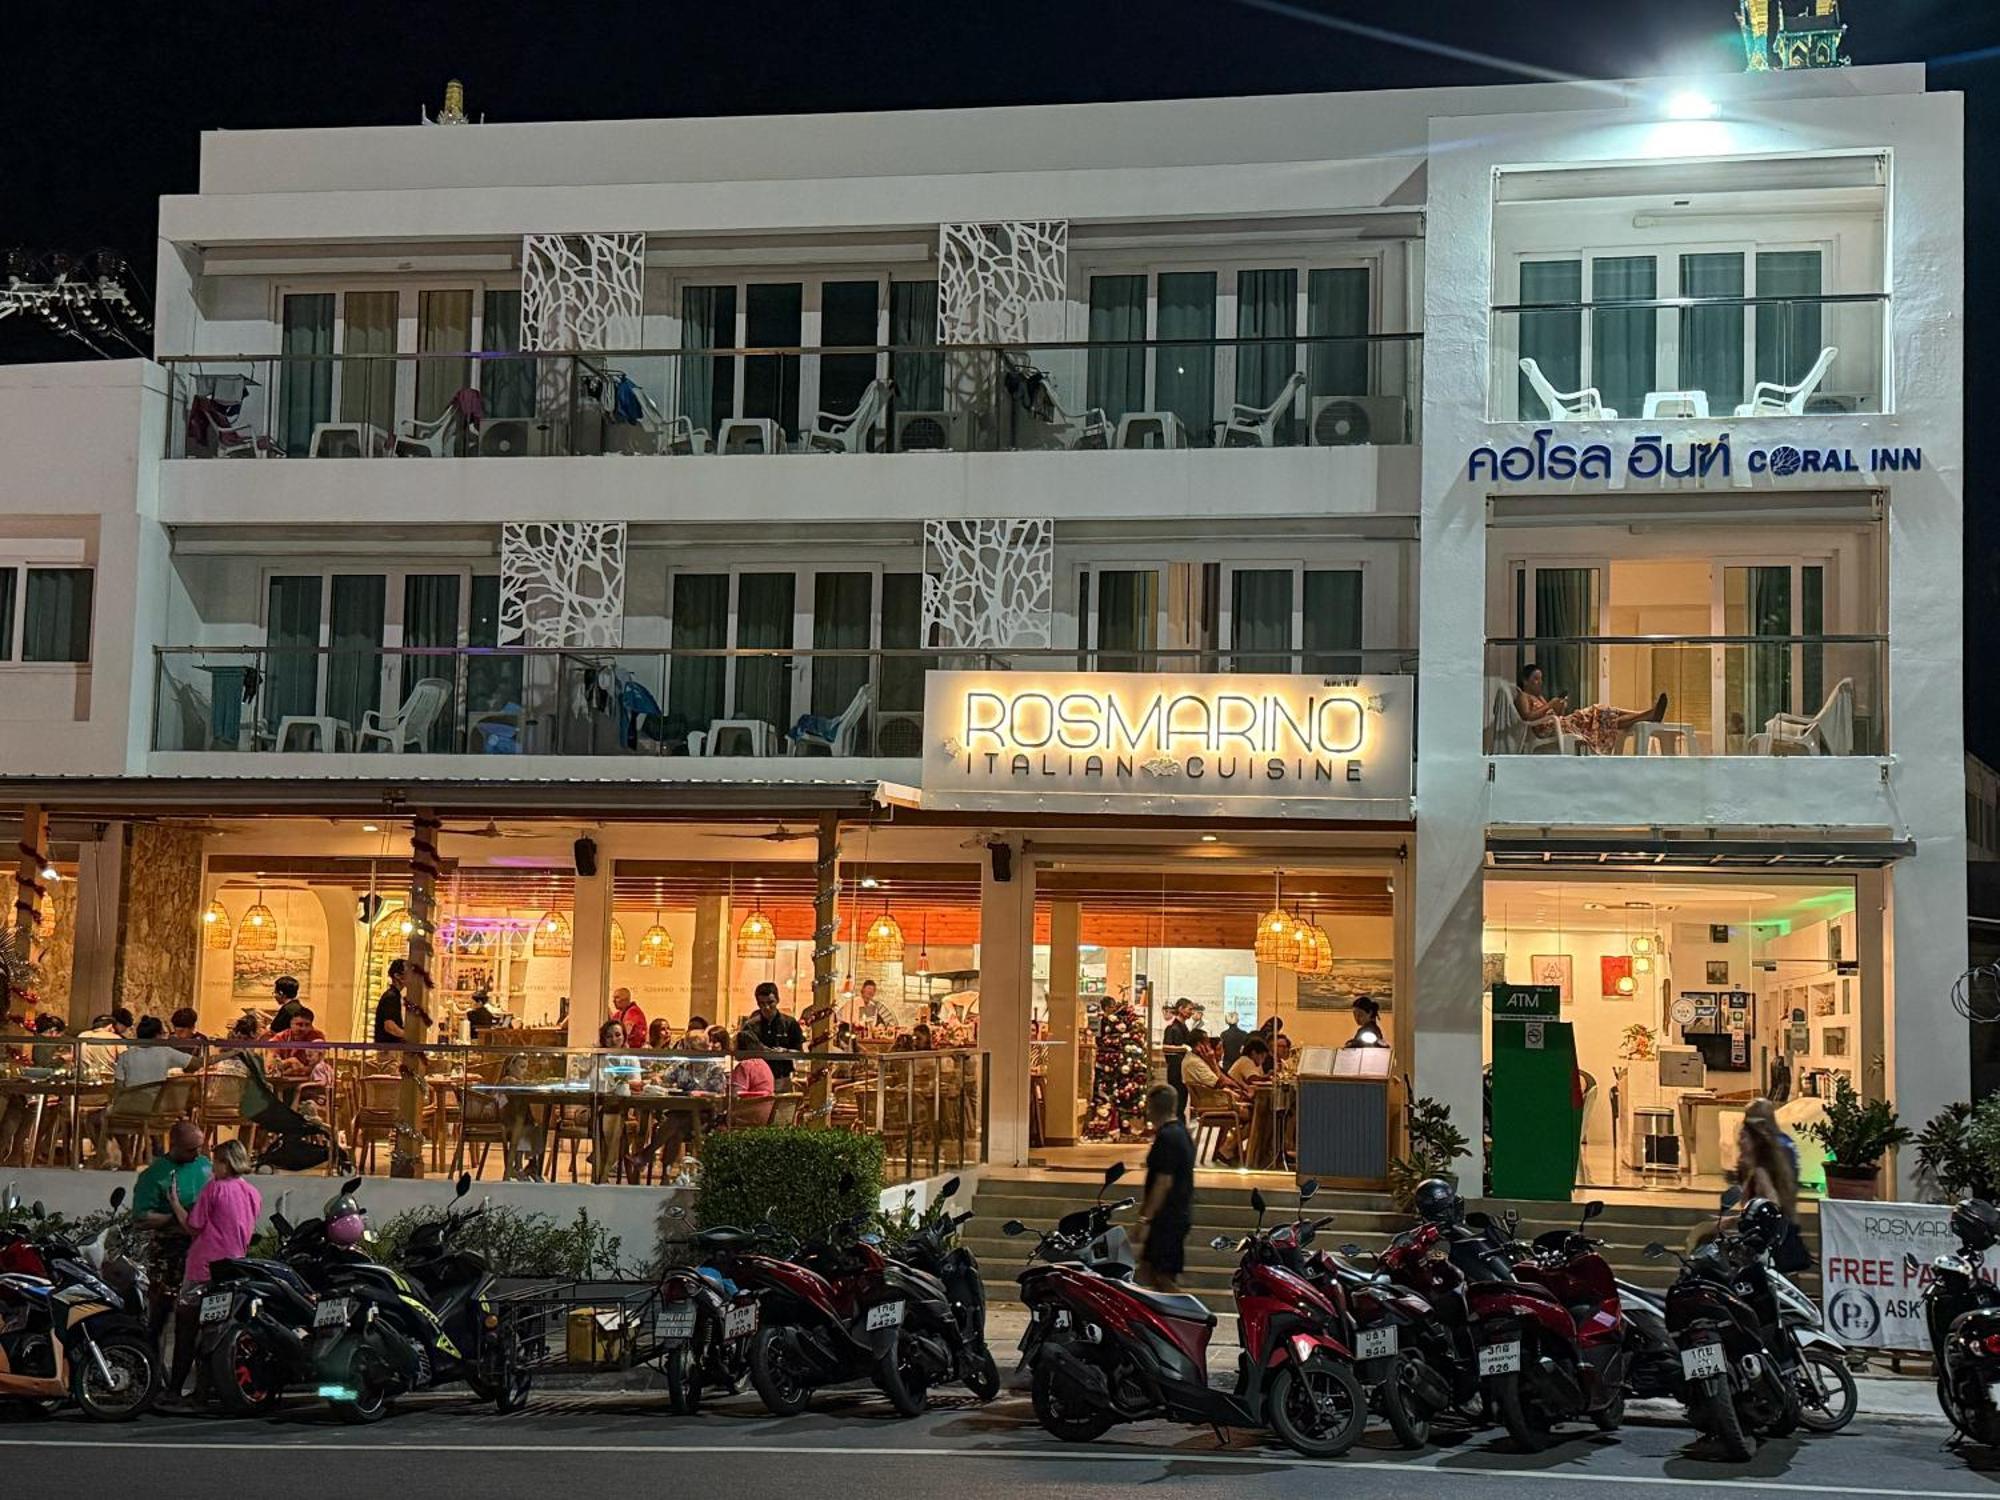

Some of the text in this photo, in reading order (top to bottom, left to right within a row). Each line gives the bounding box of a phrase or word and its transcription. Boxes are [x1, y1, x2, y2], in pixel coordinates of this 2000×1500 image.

[1468, 428, 1611, 482] คอโรล
[1747, 445, 1922, 476] CORAL INN
[966, 692, 1364, 753] ROSMARINO
[966, 752, 1362, 781] ITALIAN CUISINE
[1506, 993, 1540, 1008] ATM
[1864, 1216, 1950, 1238] ROSMAR
[1828, 1257, 1895, 1286] FREE
[1884, 1298, 1921, 1319] ASK
